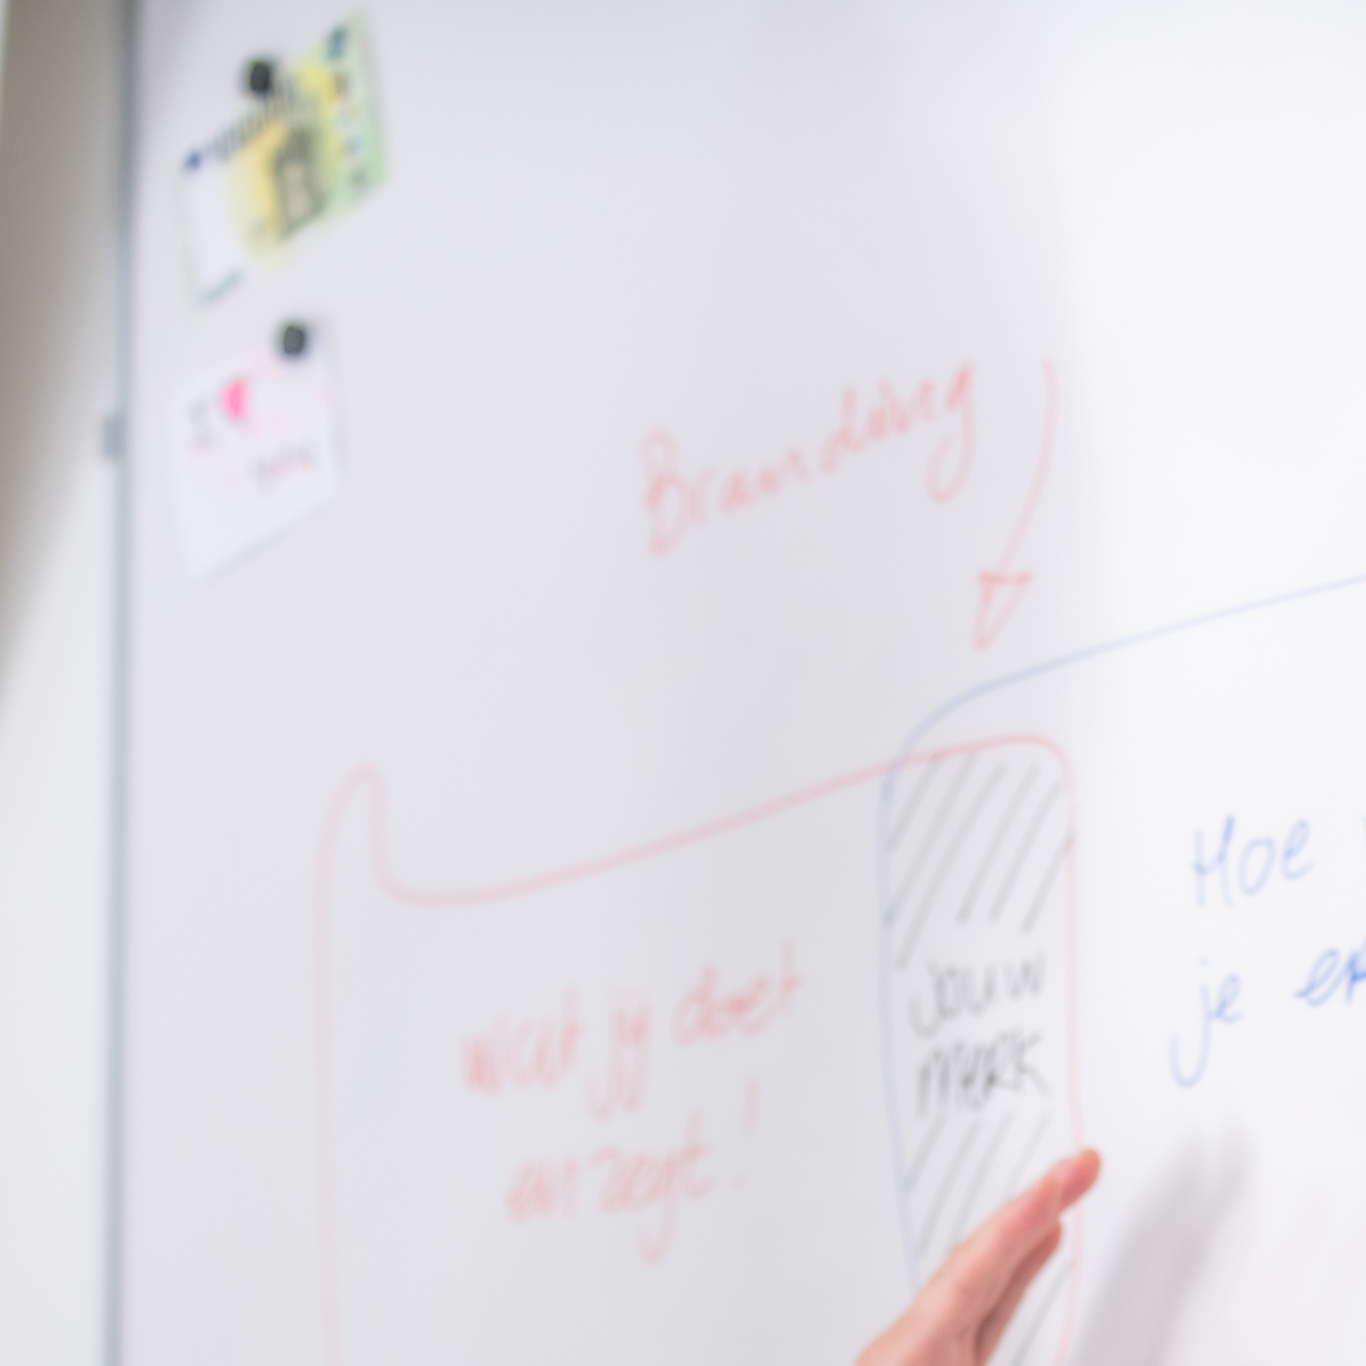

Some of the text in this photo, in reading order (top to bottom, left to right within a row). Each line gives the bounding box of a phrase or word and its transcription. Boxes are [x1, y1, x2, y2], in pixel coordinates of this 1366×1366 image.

[638, 358, 976, 556] Branding
[1191, 811, 1315, 908] Hoe
[671, 936, 805, 1048] doet
[1168, 955, 1245, 1089] je
